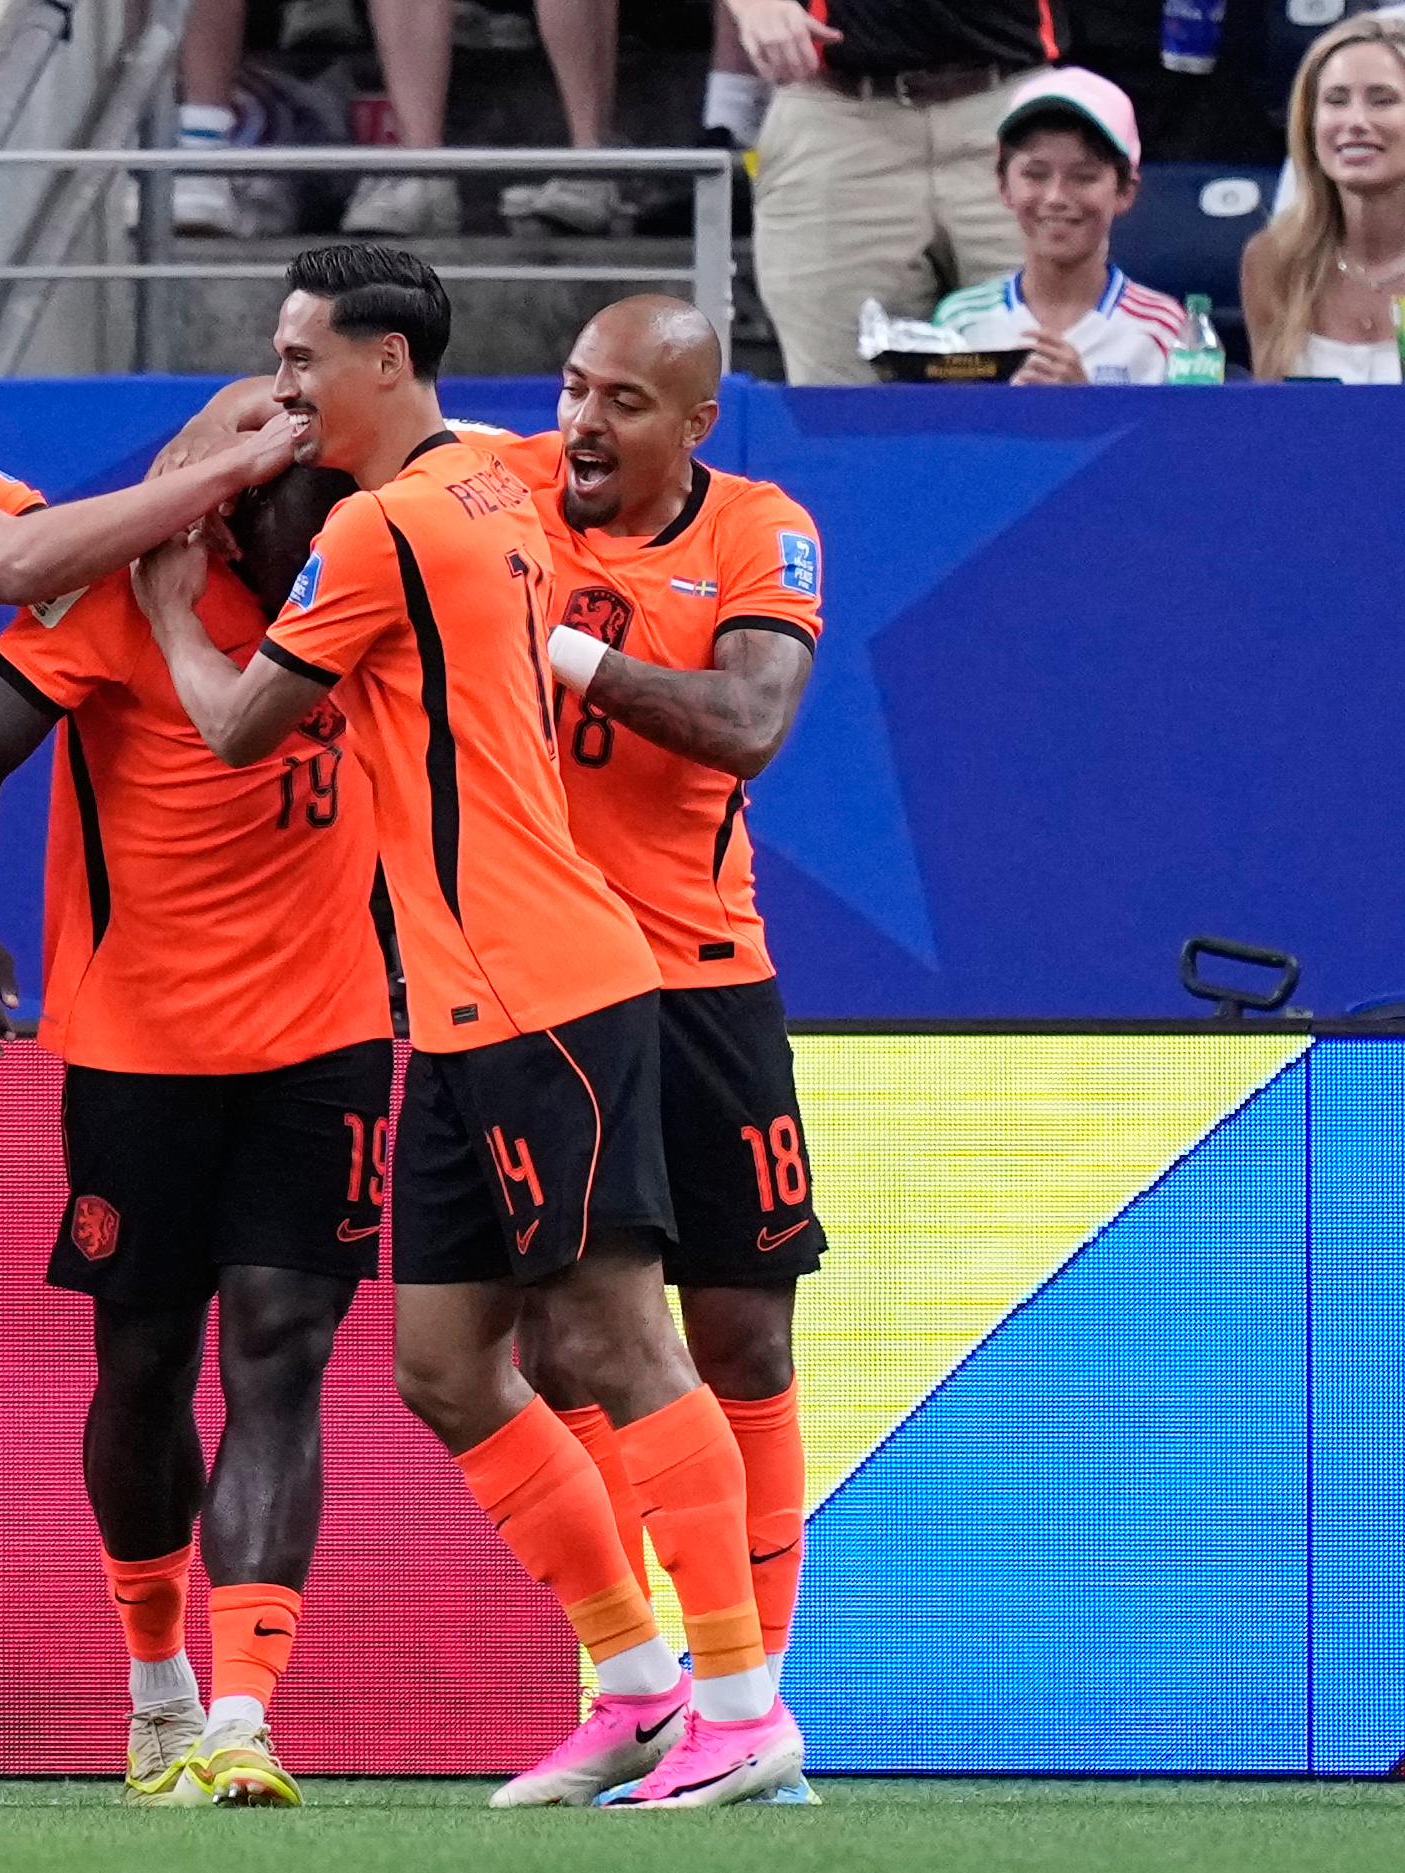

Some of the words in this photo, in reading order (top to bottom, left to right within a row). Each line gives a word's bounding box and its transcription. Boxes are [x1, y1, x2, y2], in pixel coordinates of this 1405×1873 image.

[276, 746, 343, 830] 19
[344, 1112, 389, 1207] 19
[484, 1125, 545, 1216] 14
[741, 1115, 807, 1212] 18
